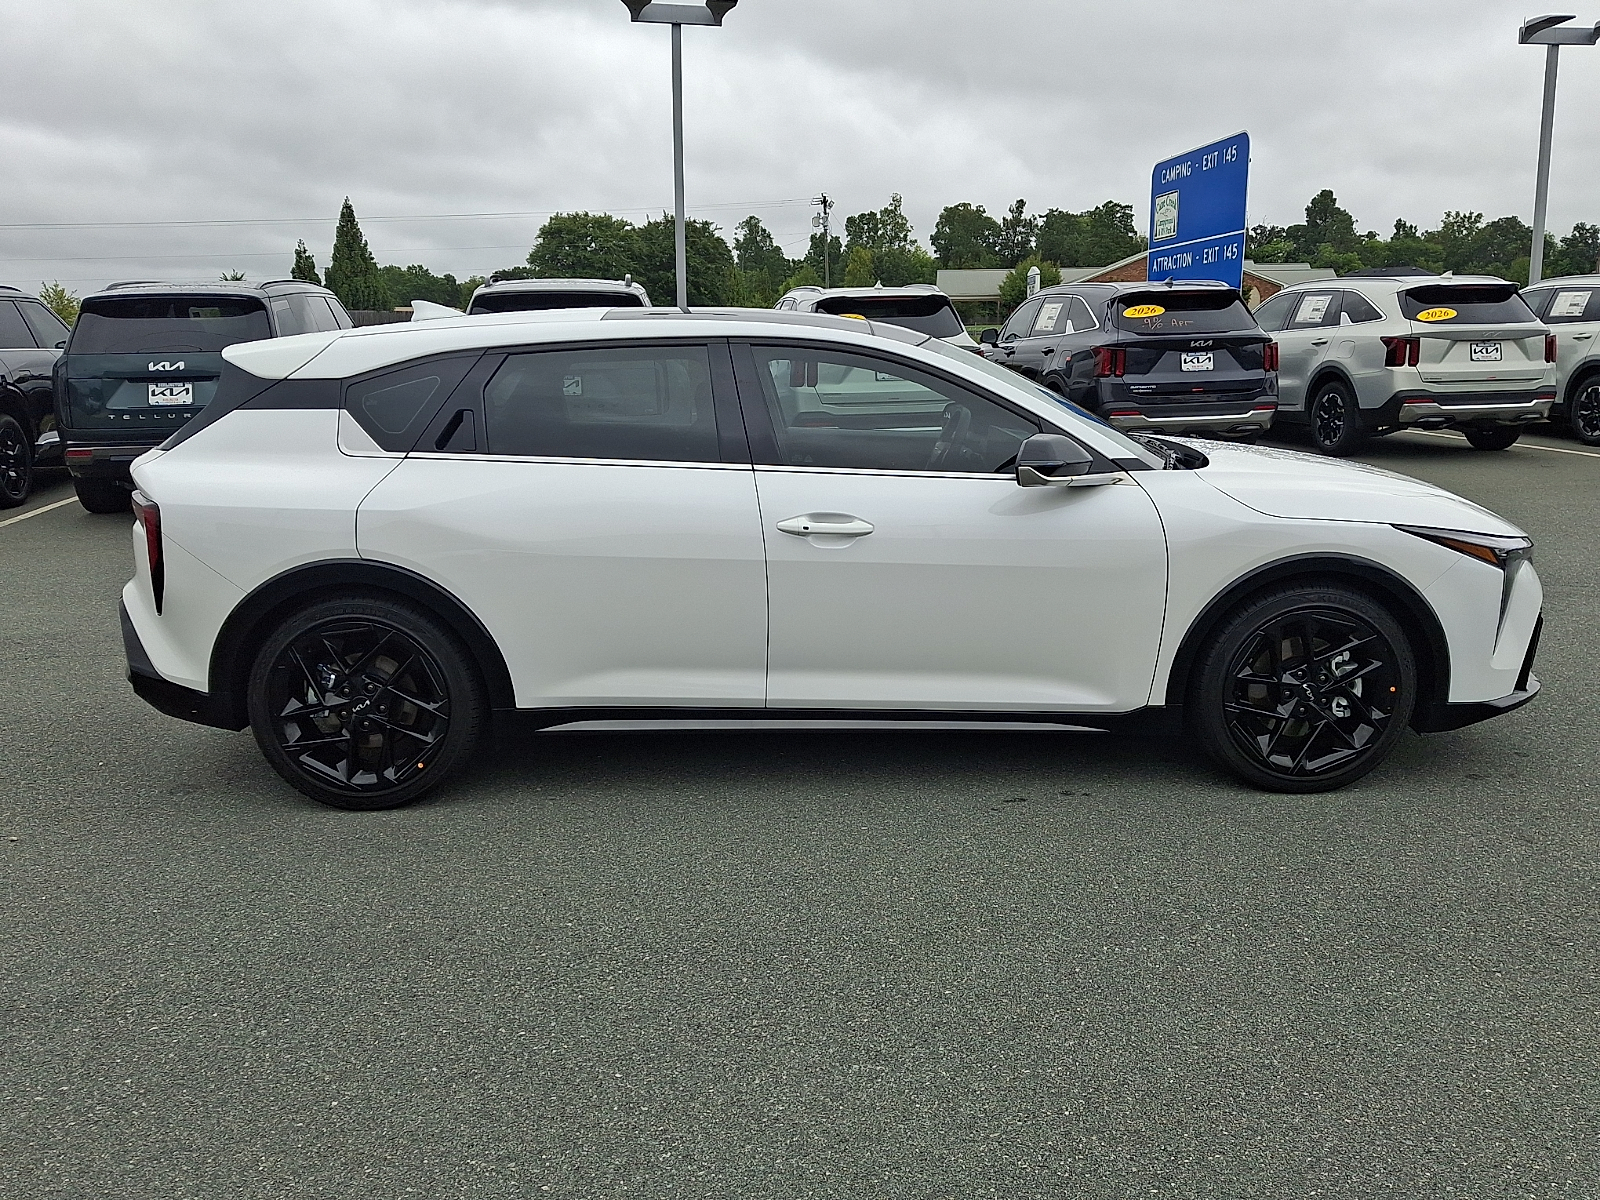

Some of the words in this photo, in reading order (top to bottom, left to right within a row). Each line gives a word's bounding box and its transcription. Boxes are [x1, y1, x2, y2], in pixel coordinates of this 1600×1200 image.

[1161, 160, 1192, 184] CAMPING
[1202, 151, 1219, 171] EXIT
[1223, 145, 1238, 164] 145
[1152, 252, 1193, 273] ATTRACTION
[1203, 246, 1220, 264] EXIT
[1223, 243, 1238, 261] 145
[1131, 306, 1157, 316] 2026
[1425, 310, 1449, 319] 2026
[1190, 340, 1213, 348] KIA
[1474, 346, 1499, 355] KIA
[1183, 356, 1212, 365] KIA
[148, 361, 185, 371] KIA
[151, 387, 190, 397] KIA
